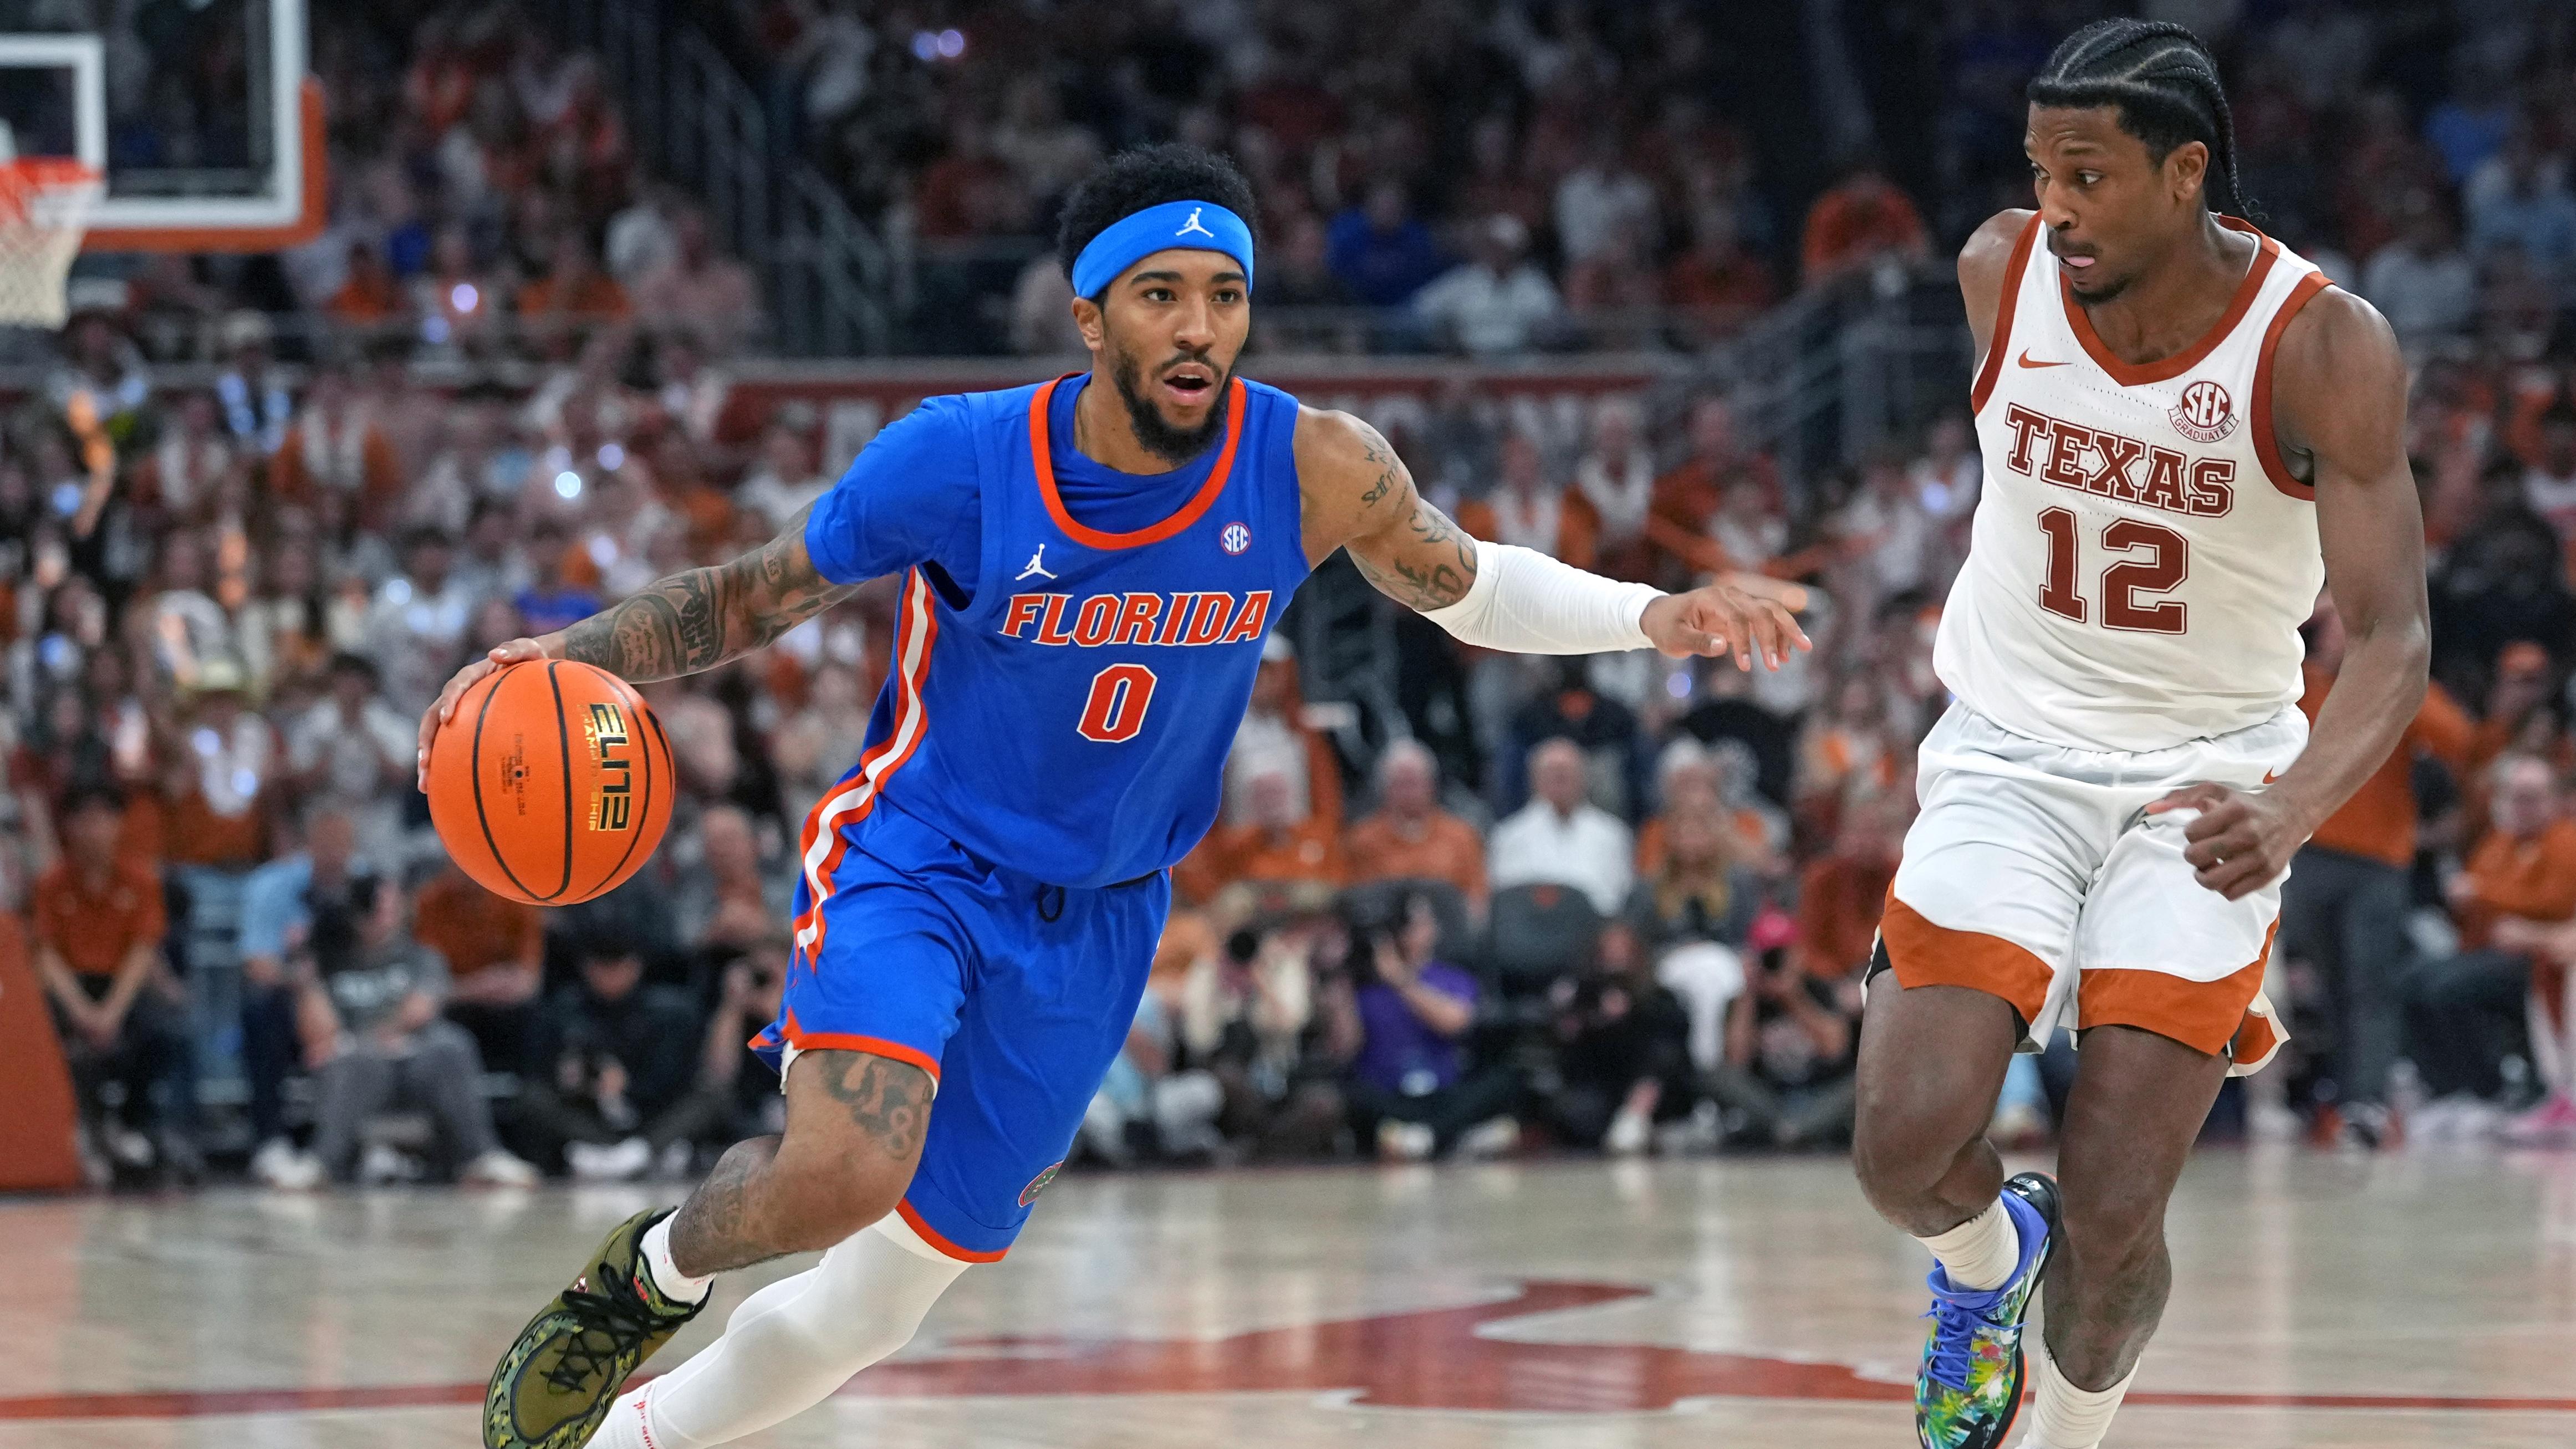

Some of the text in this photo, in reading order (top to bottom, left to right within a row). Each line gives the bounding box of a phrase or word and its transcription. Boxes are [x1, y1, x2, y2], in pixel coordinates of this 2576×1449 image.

[2174, 417, 2229, 441] GRADUATE
[2184, 382, 2228, 426] SEC
[2004, 402, 2236, 518] TEXAS
[1223, 524, 1249, 553] SEC
[2037, 506, 2189, 635] 12
[997, 590, 1272, 647] FLORIDA
[1076, 663, 1158, 743] 0
[589, 703, 632, 831] ELITE
